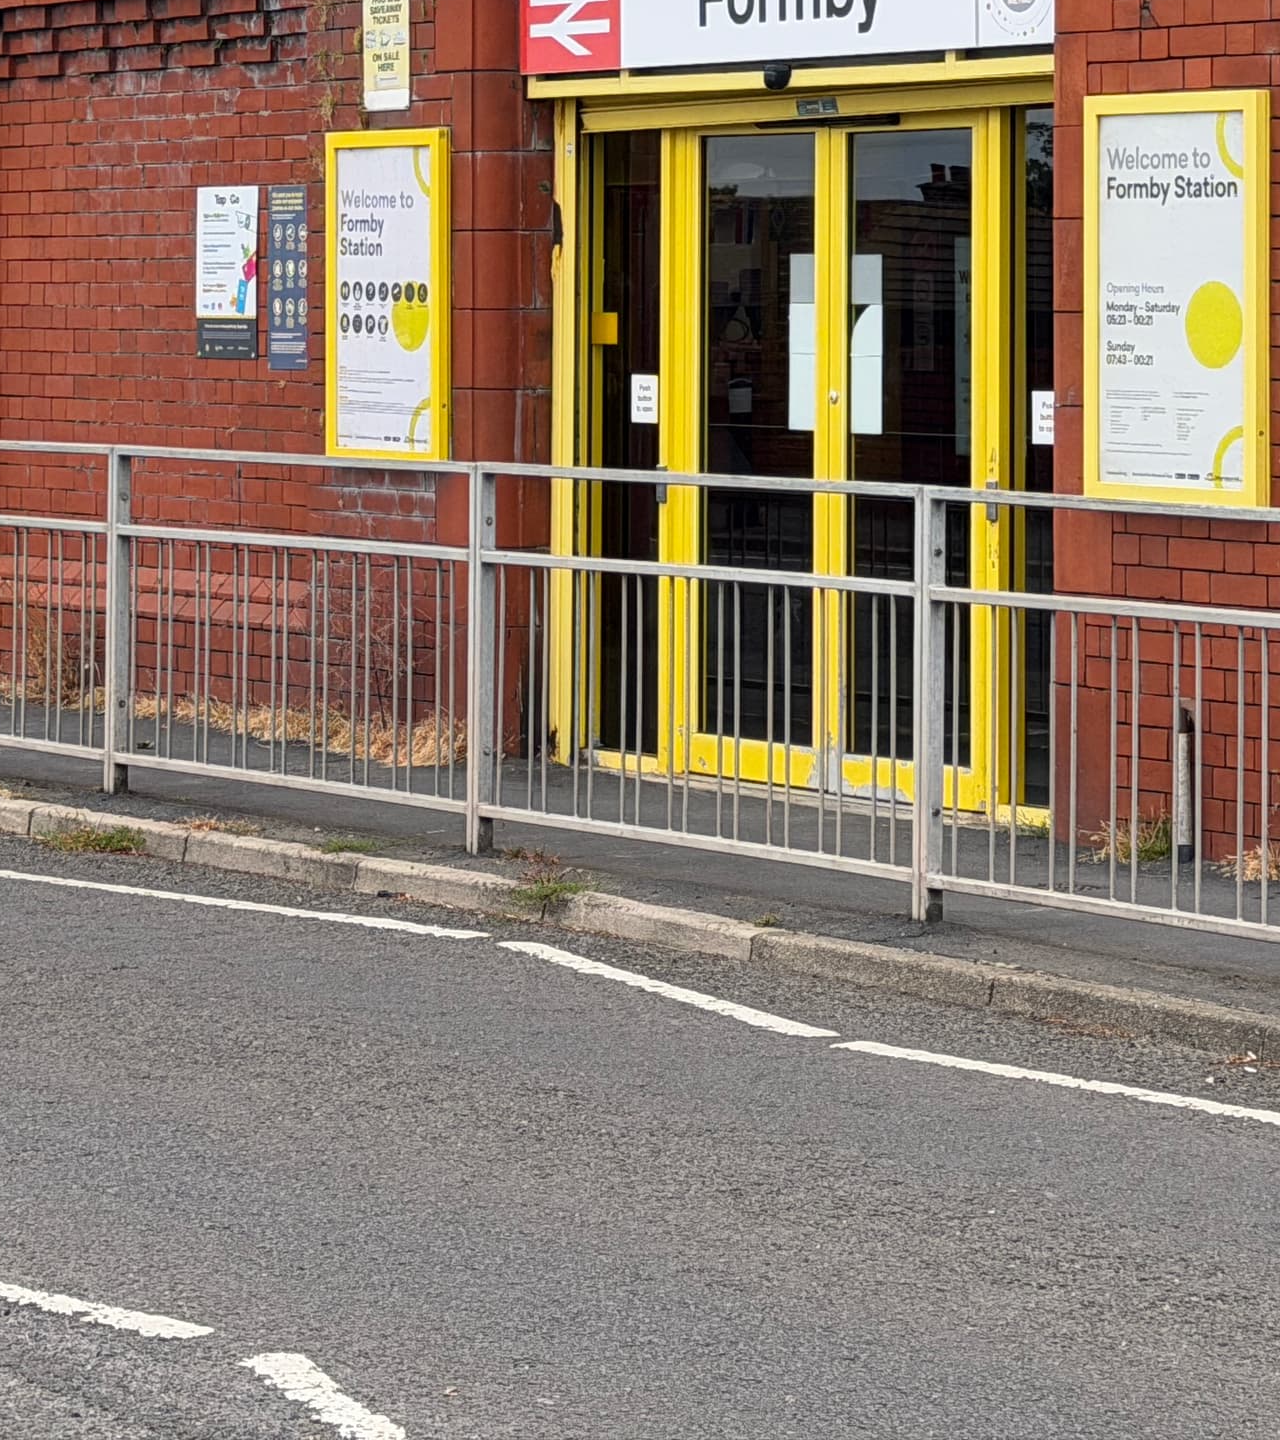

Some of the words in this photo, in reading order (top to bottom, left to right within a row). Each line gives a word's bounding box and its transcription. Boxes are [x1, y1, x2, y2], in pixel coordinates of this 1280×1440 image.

[373, 15, 400, 25] TICKETS
[372, 53, 382, 63] ON
[384, 50, 400, 62] SALE
[377, 62, 395, 72] HERE
[1107, 146, 1188, 170] Welcome
[1192, 147, 1211, 169] to
[1107, 176, 1171, 206] Formby
[1174, 174, 1238, 198] Station
[341, 189, 397, 208] Welcome
[400, 191, 414, 208] to
[340, 212, 384, 239] Formby
[340, 237, 382, 256] Station
[1106, 282, 1140, 296] Opening
[1141, 282, 1164, 293] Hours
[1106, 301, 1137, 315] Monday
[1145, 301, 1180, 316] Saturday
[1106, 340, 1135, 355] Sunday
